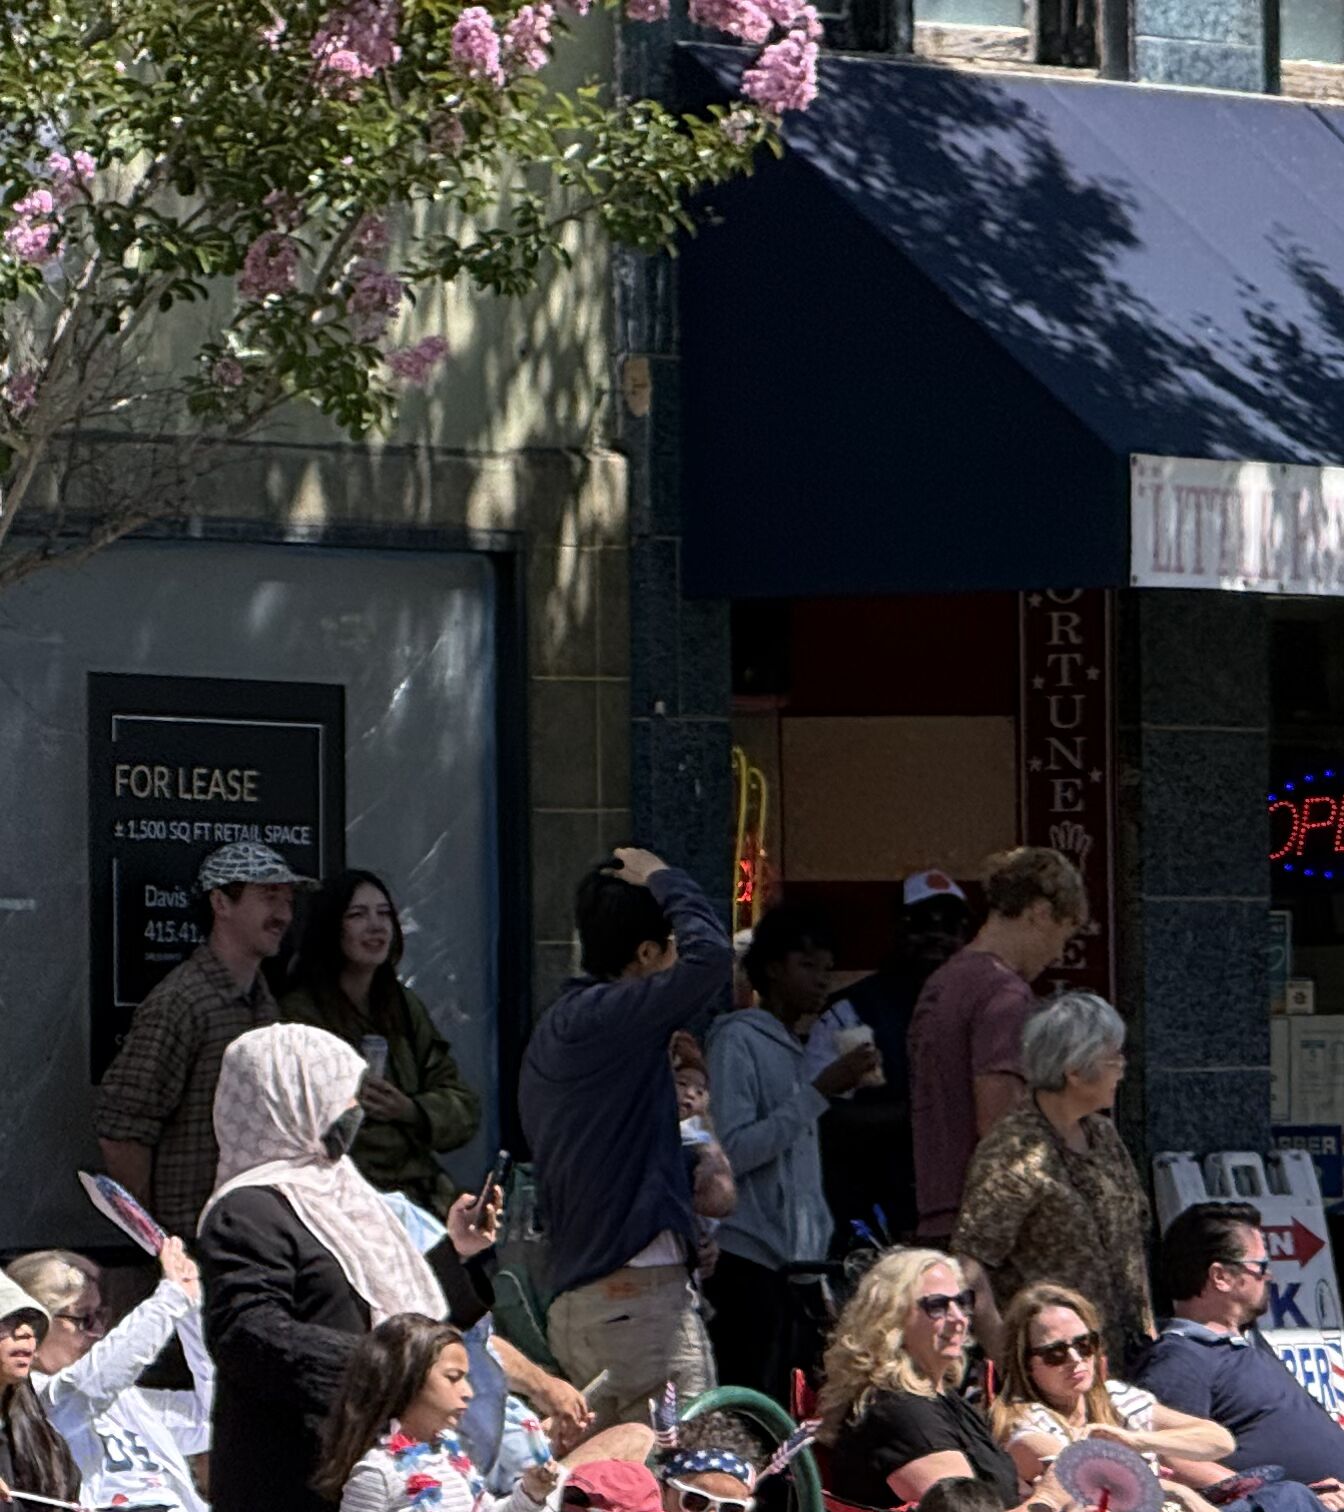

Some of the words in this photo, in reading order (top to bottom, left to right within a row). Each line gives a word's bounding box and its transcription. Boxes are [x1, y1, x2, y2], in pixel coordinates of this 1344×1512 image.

[115, 764, 171, 798] FOR
[178, 767, 260, 802] LEASE
[127, 820, 167, 841] 1,500
[169, 822, 191, 843] SQ
[193, 822, 212, 841] FT
[214, 823, 263, 843] RETAIL
[265, 825, 312, 845] SPACE
[144, 884, 188, 908] Davis
